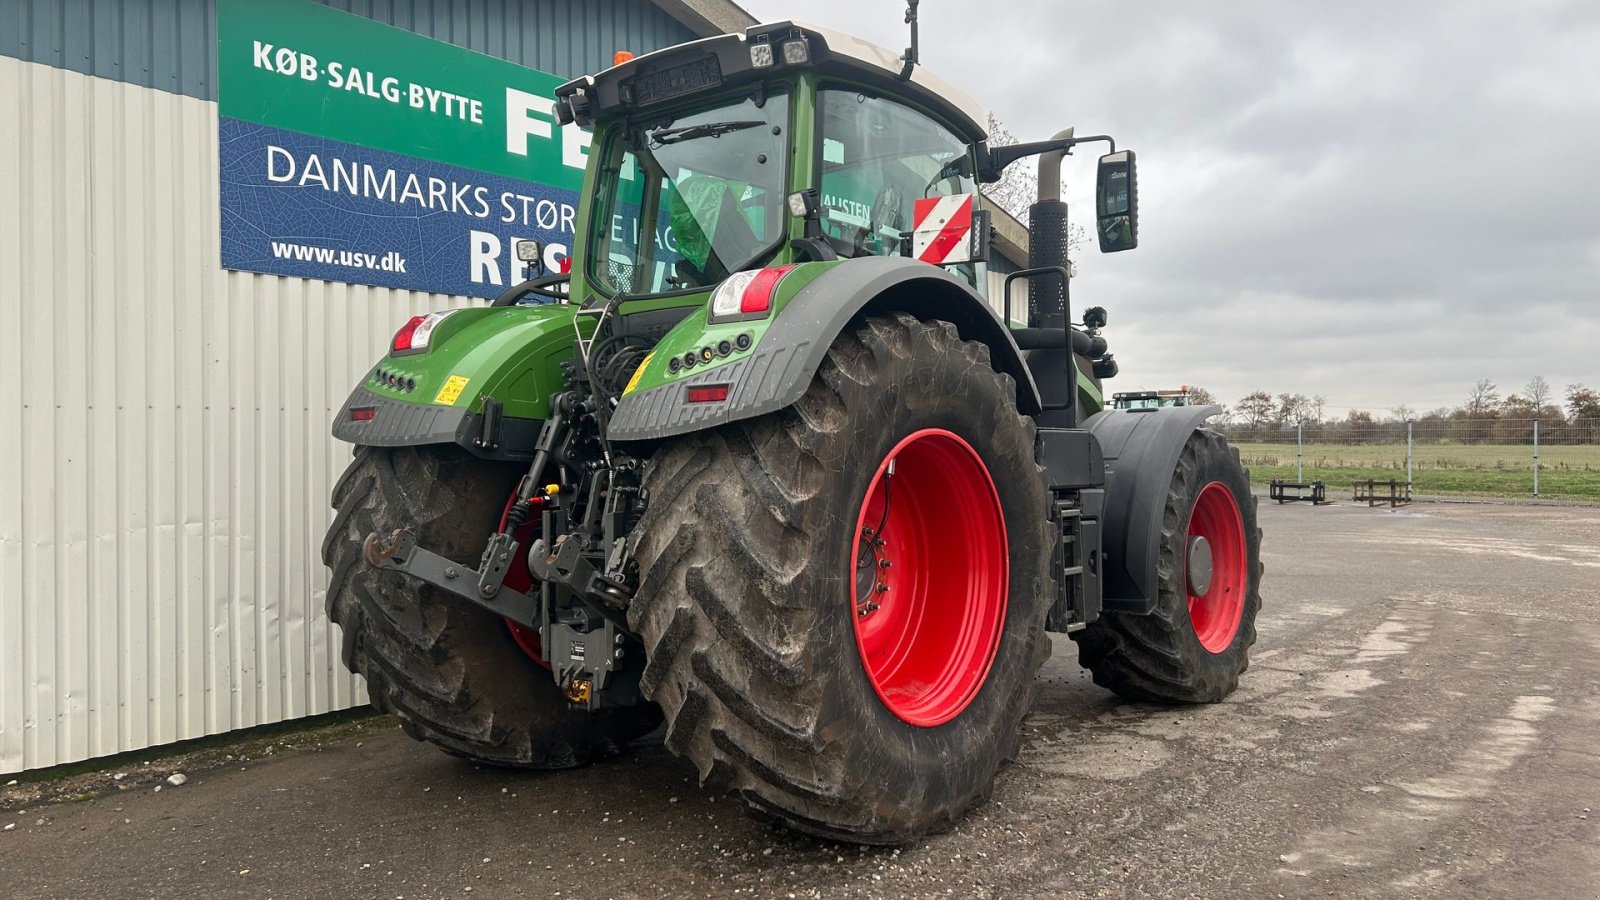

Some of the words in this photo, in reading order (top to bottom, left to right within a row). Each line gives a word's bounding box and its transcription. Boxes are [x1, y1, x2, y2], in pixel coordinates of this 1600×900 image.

[267, 145, 490, 217] DANMARKS
[820, 193, 870, 220] AUSTEN
[271, 241, 407, 274] www.usv.dk
